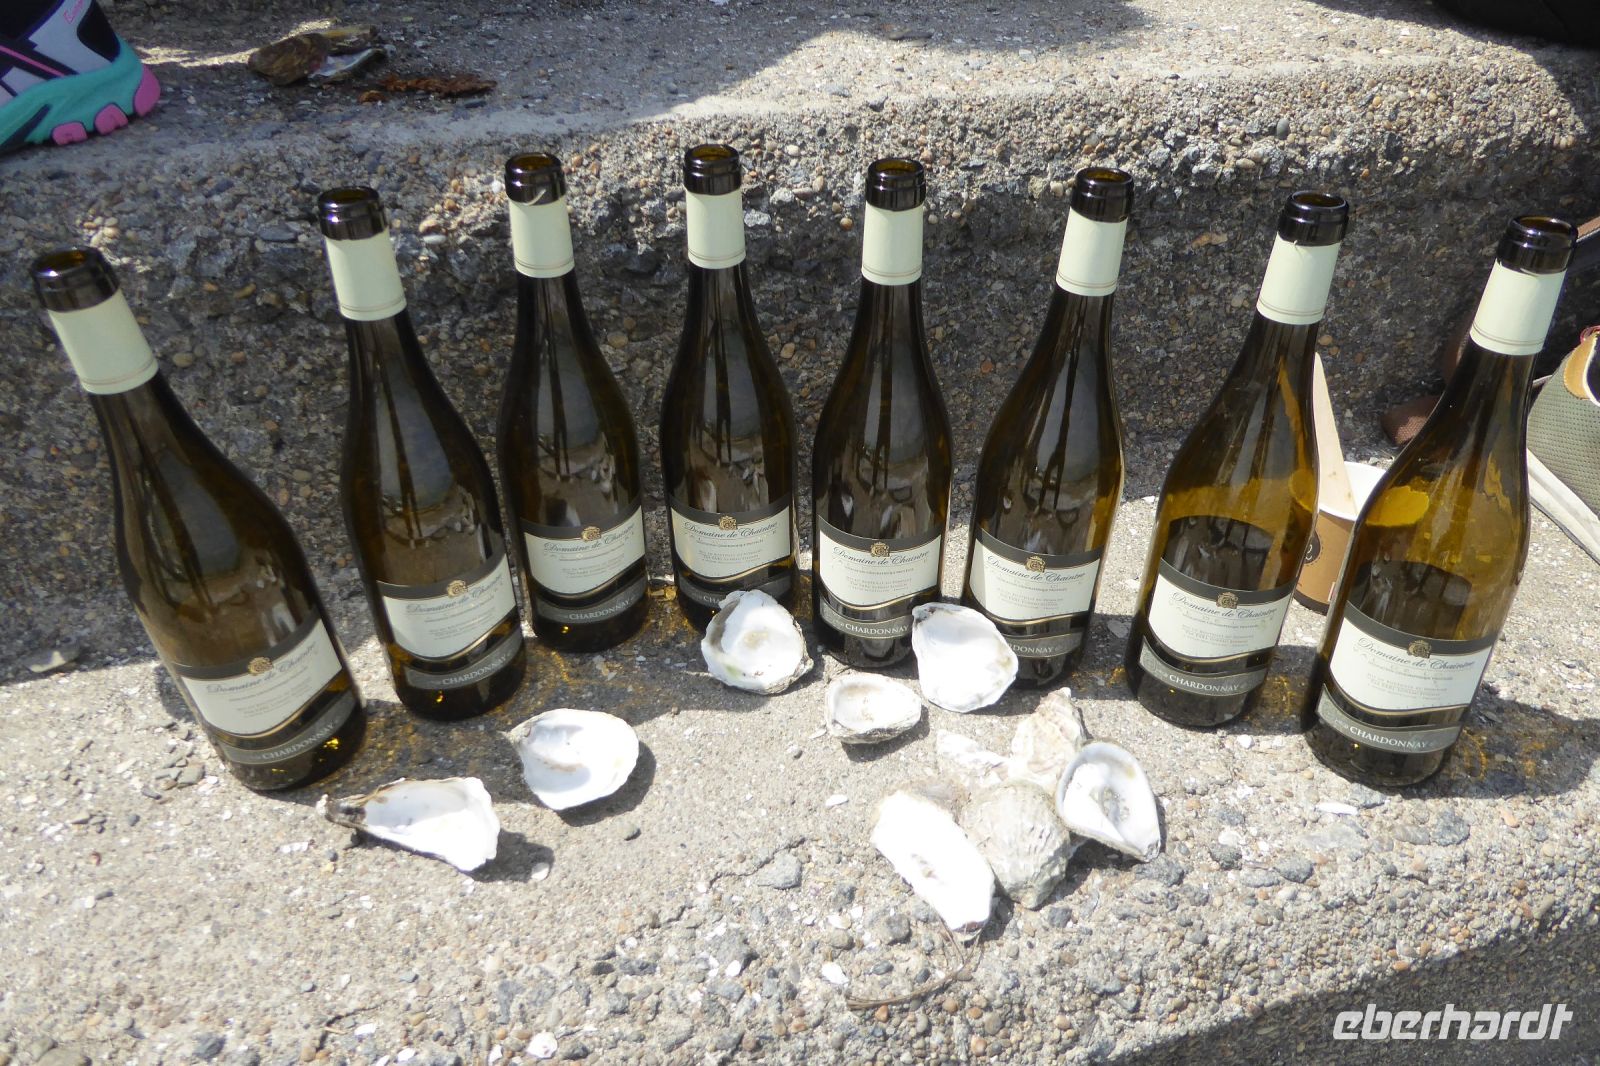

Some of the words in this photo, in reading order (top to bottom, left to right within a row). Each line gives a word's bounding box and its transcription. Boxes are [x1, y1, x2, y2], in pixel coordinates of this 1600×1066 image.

[726, 530, 738, 539] de
[591, 540, 602, 549] de
[877, 557, 889, 565] de
[1031, 571, 1044, 581] de
[569, 599, 631, 620] CHARDONNAY
[1221, 609, 1235, 618] de
[845, 623, 909, 635] CHARDONNAY
[1358, 637, 1410, 665] Domaine
[1411, 658, 1427, 668] de
[442, 656, 507, 685] CHARDONNAY
[1169, 674, 1240, 693] CHARDONNAY
[262, 722, 335, 760] CHARDONNAY
[1350, 726, 1428, 749] CHARDONNAY
